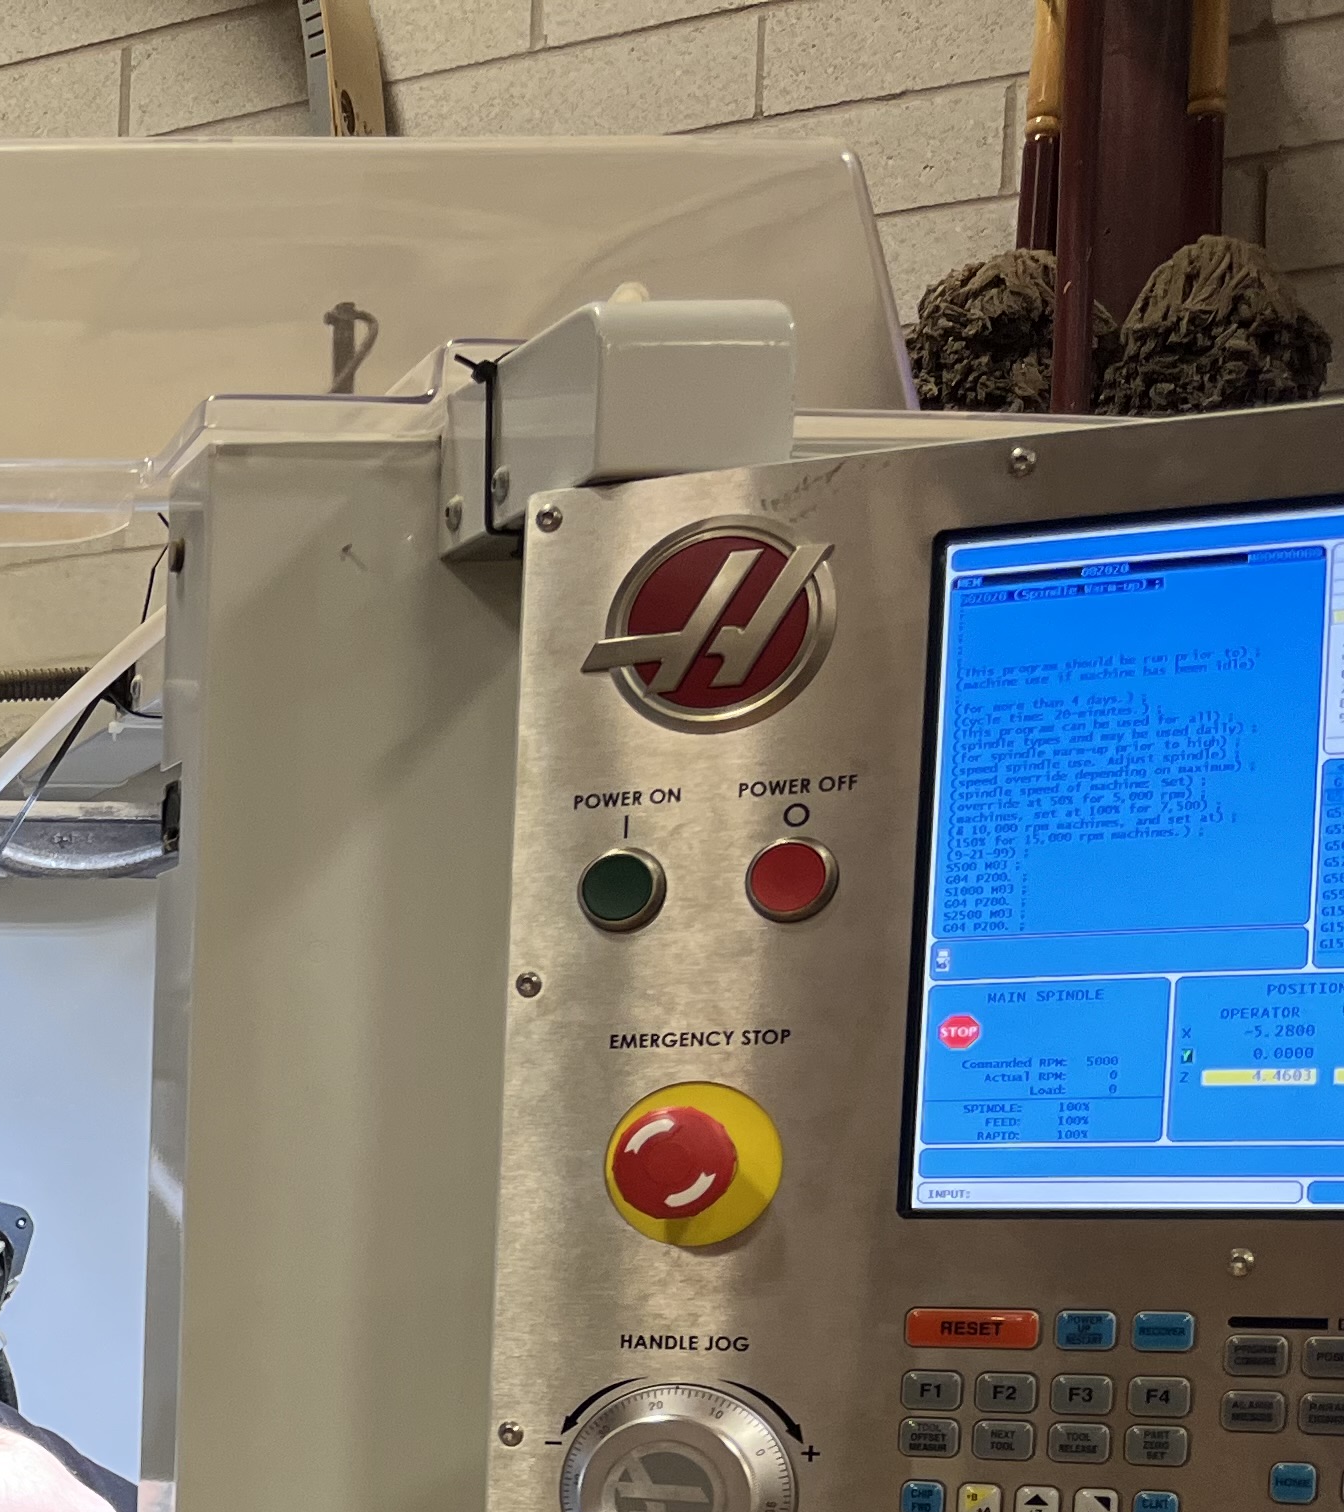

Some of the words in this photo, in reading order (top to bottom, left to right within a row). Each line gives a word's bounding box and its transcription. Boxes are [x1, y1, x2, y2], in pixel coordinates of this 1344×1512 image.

[738, 778, 810, 798] POWER
[818, 774, 858, 792] OFF
[573, 791, 642, 810] POWER
[649, 788, 681, 803] ON
[988, 991, 1027, 1004] MAIN
[1037, 989, 1105, 1002] SPINDLE
[1220, 1006, 1300, 1020] OPERATOR
[940, 1026, 977, 1038] STOP
[1182, 1028, 1192, 1039] X
[1244, 1024, 1316, 1037] -5.2800
[609, 1030, 736, 1050] EMERGENCY
[741, 1028, 792, 1047] STOP
[1253, 1047, 1314, 1060] 0.0000
[962, 1057, 1032, 1069] Commanded
[1086, 1056, 1119, 1067] 5000
[984, 1071, 1030, 1083] Actual
[1109, 1070, 1118, 1081] 0
[1029, 1085, 1067, 1096] Load:
[1108, 1084, 1117, 1095] 0
[963, 1103, 1023, 1114] SPINDLE:
[1058, 1102, 1090, 1112] 100%
[985, 1116, 1021, 1127] FEED:
[1057, 1115, 1089, 1126] 100%
[1056, 1129, 1089, 1140] 100%
[928, 1189, 971, 1199] INPUT:
[940, 1321, 1003, 1336] RESET
[620, 1334, 698, 1351] HANDLE
[705, 1336, 750, 1351] JOG
[919, 1383, 942, 1398] F1
[992, 1385, 1017, 1400] F2
[1068, 1387, 1093, 1402] F3
[1146, 1389, 1170, 1404] F4
[649, 1400, 664, 1411] 20
[710, 1407, 725, 1420] 10
[991, 1430, 1016, 1439] NEXT
[1066, 1432, 1091, 1442] TOOL
